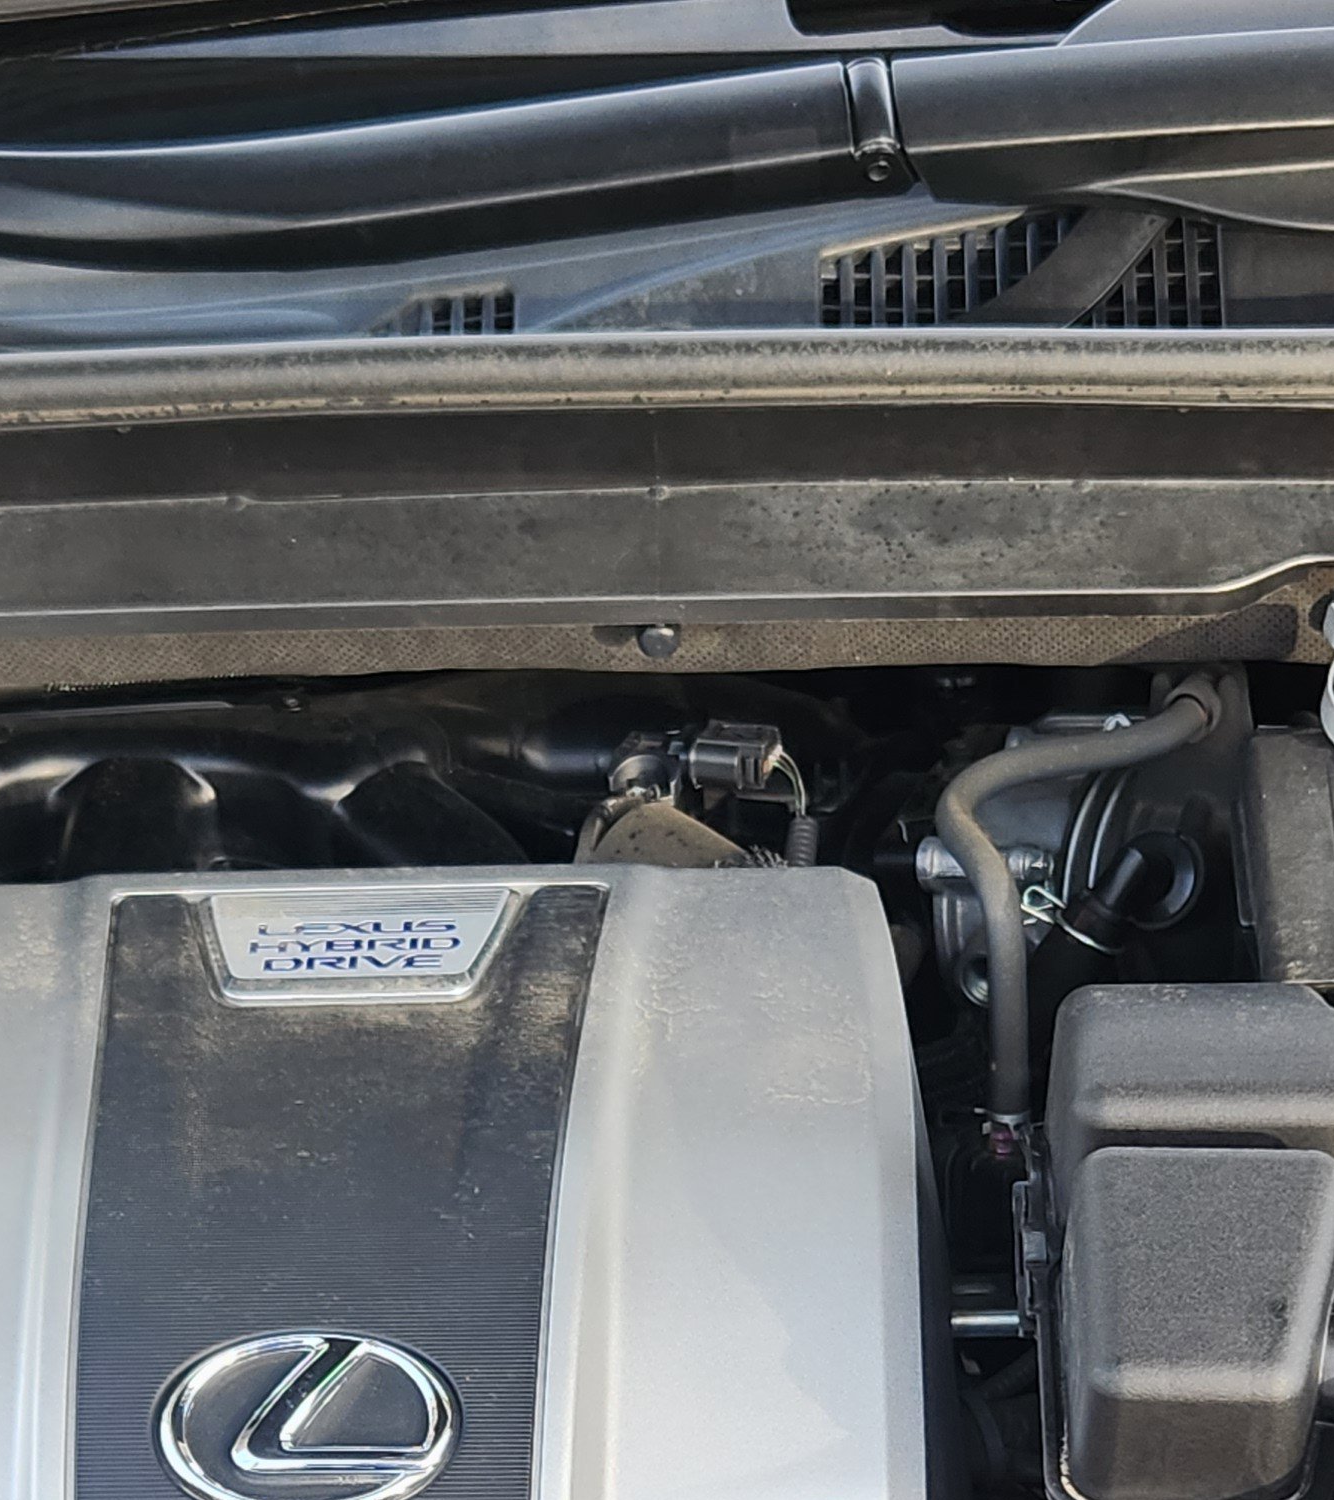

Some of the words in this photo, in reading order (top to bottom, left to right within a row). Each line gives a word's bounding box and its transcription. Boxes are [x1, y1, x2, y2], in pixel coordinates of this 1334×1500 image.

[258, 919, 456, 936] LEXUS
[248, 936, 461, 954] HYBRID
[263, 955, 442, 971] DRIVE
